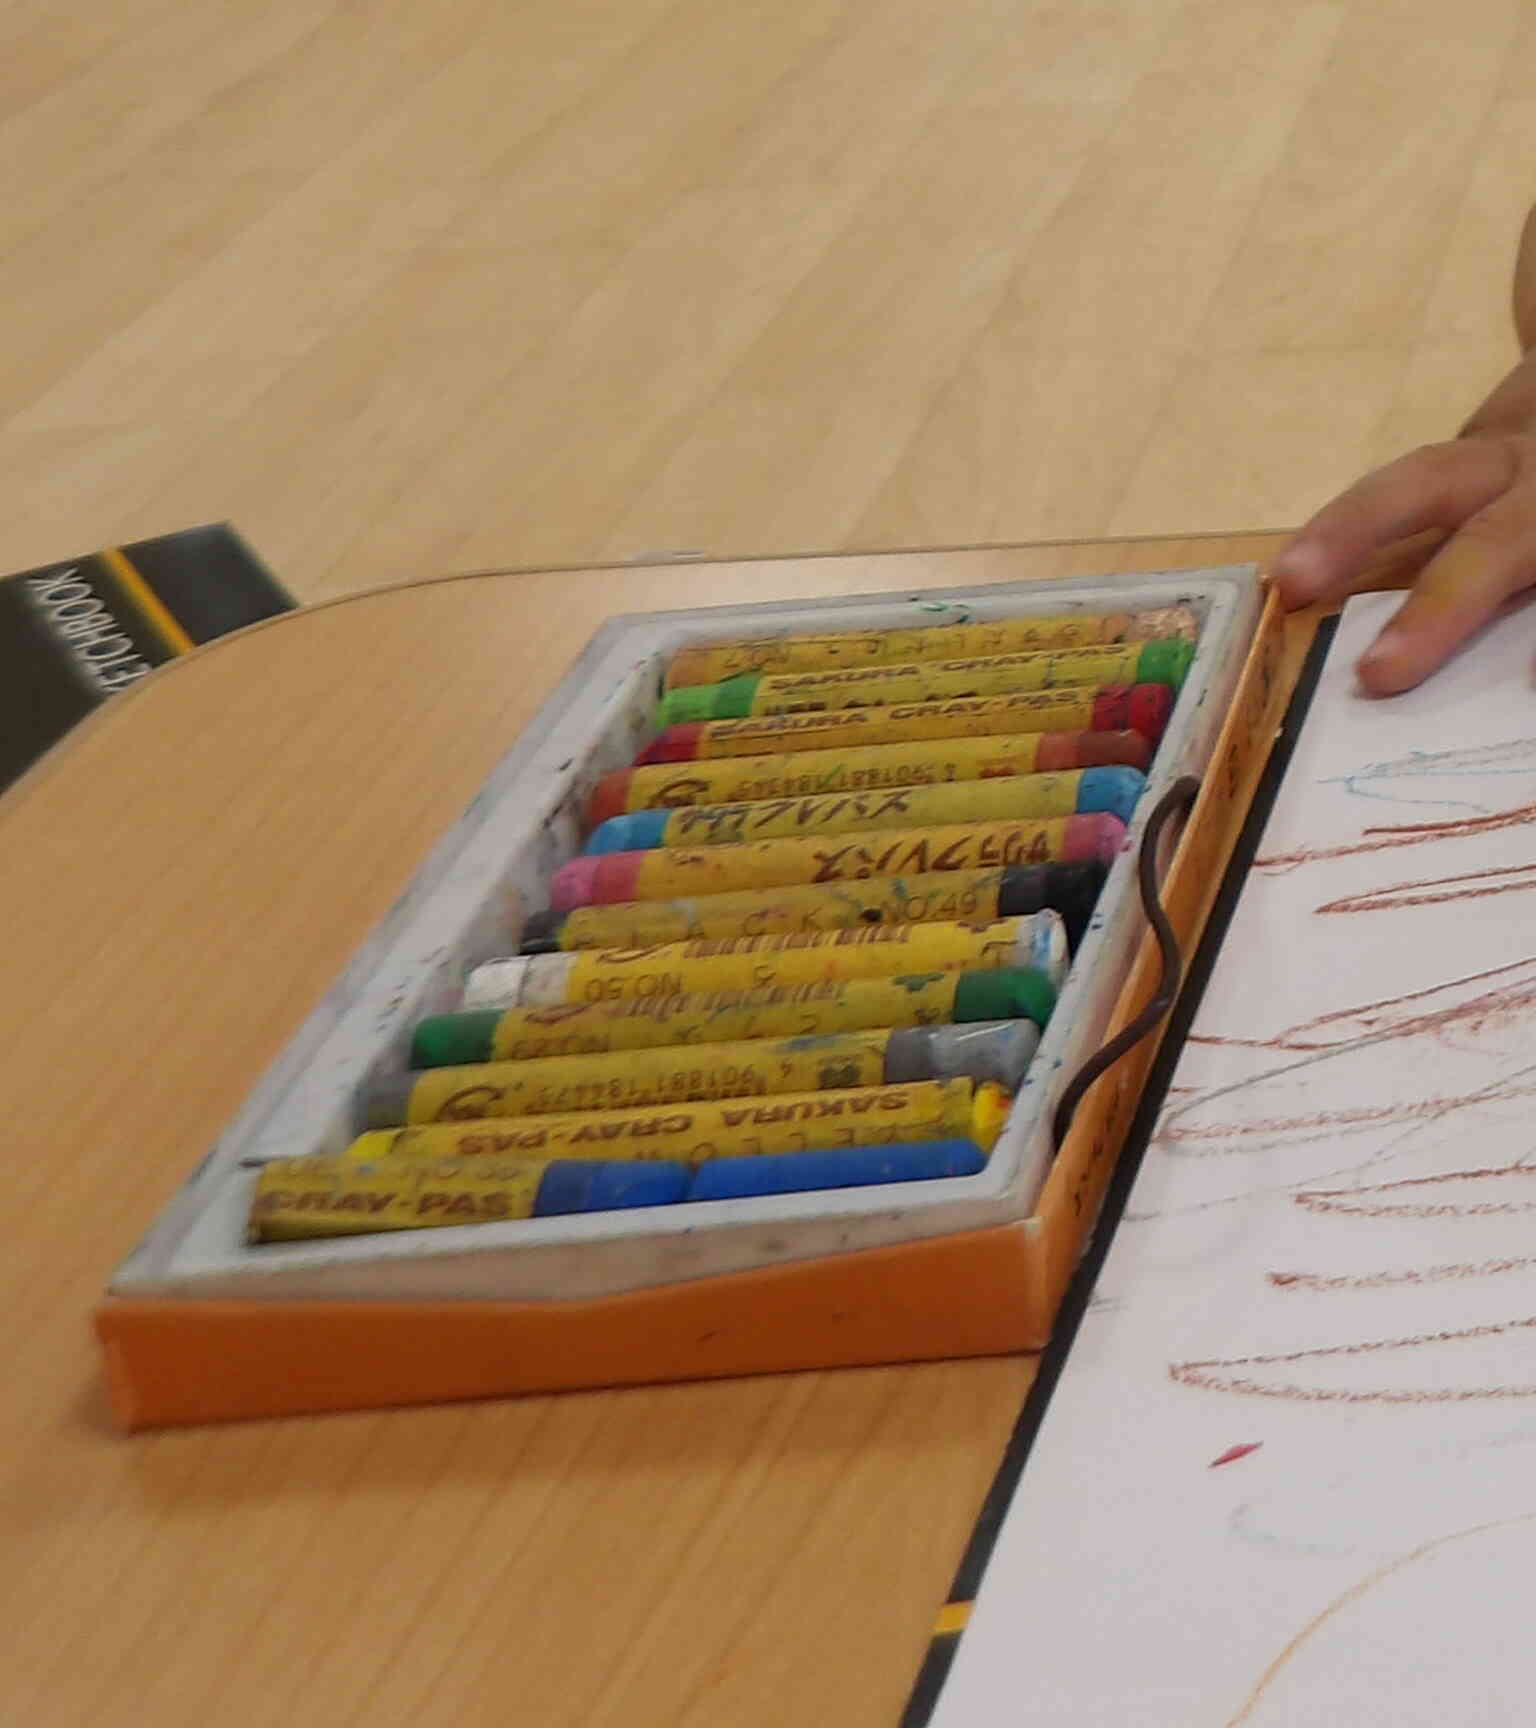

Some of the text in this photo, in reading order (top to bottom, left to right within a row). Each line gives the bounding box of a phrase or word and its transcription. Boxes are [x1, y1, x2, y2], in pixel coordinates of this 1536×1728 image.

[25, 567, 150, 692] ETCHBOOK
[455, 1091, 911, 1156] SAKURA CRAY-PAS
